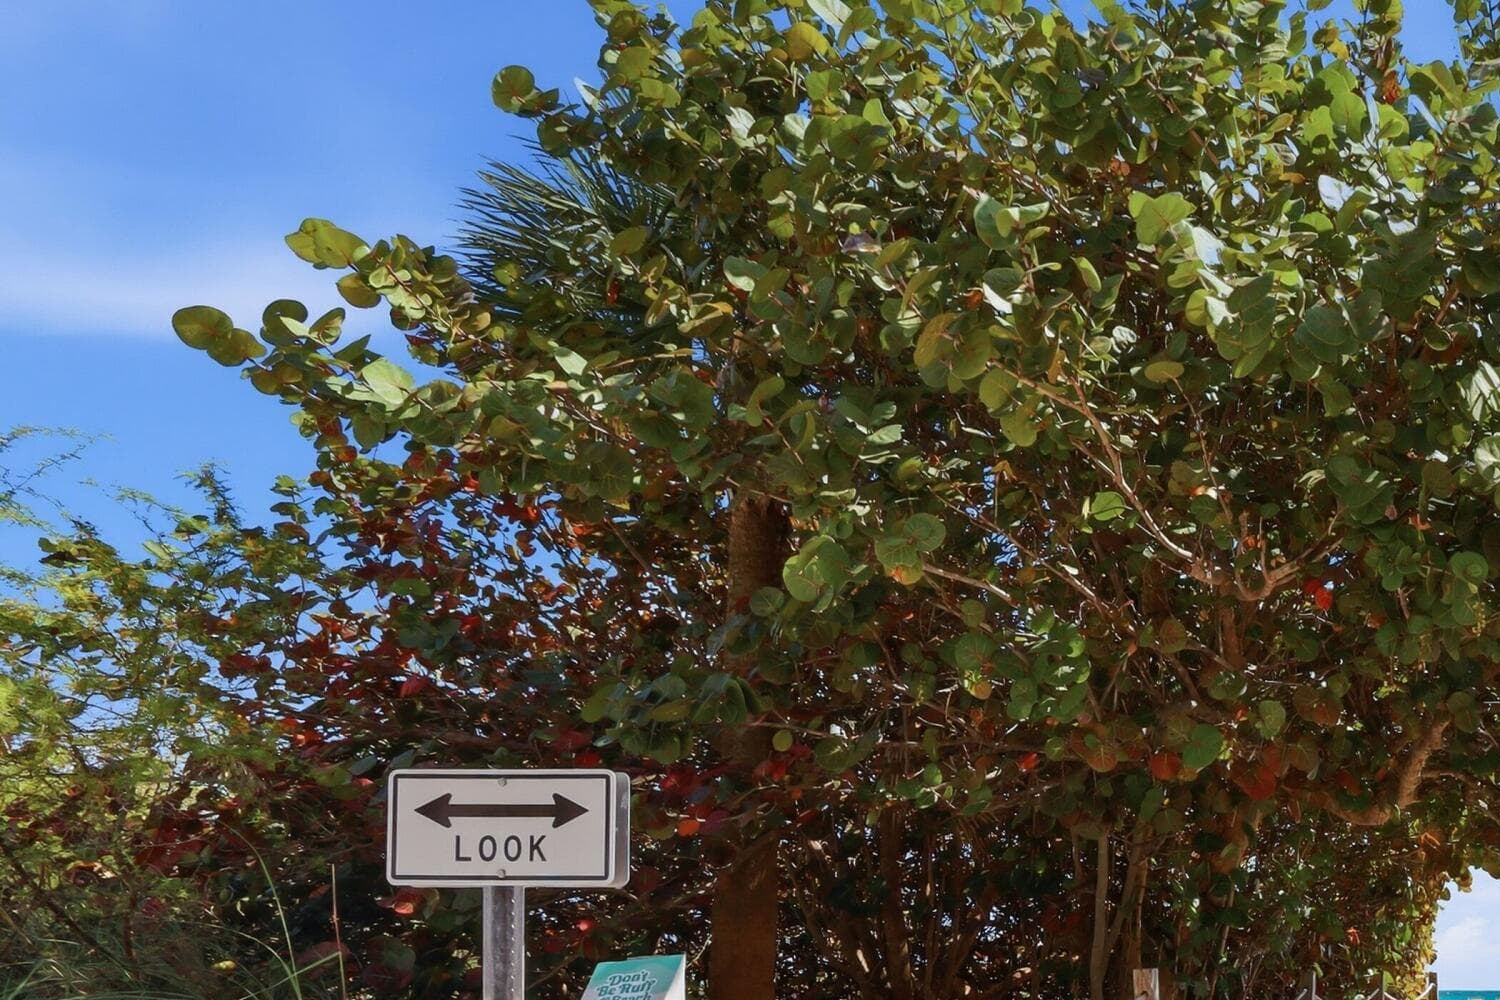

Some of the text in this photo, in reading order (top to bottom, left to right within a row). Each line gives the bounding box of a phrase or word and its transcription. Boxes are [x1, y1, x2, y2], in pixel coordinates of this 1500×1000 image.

[455, 835, 547, 861] LOOK
[608, 970, 649, 987] Don't
[597, 979, 657, 997] Be Ruff
